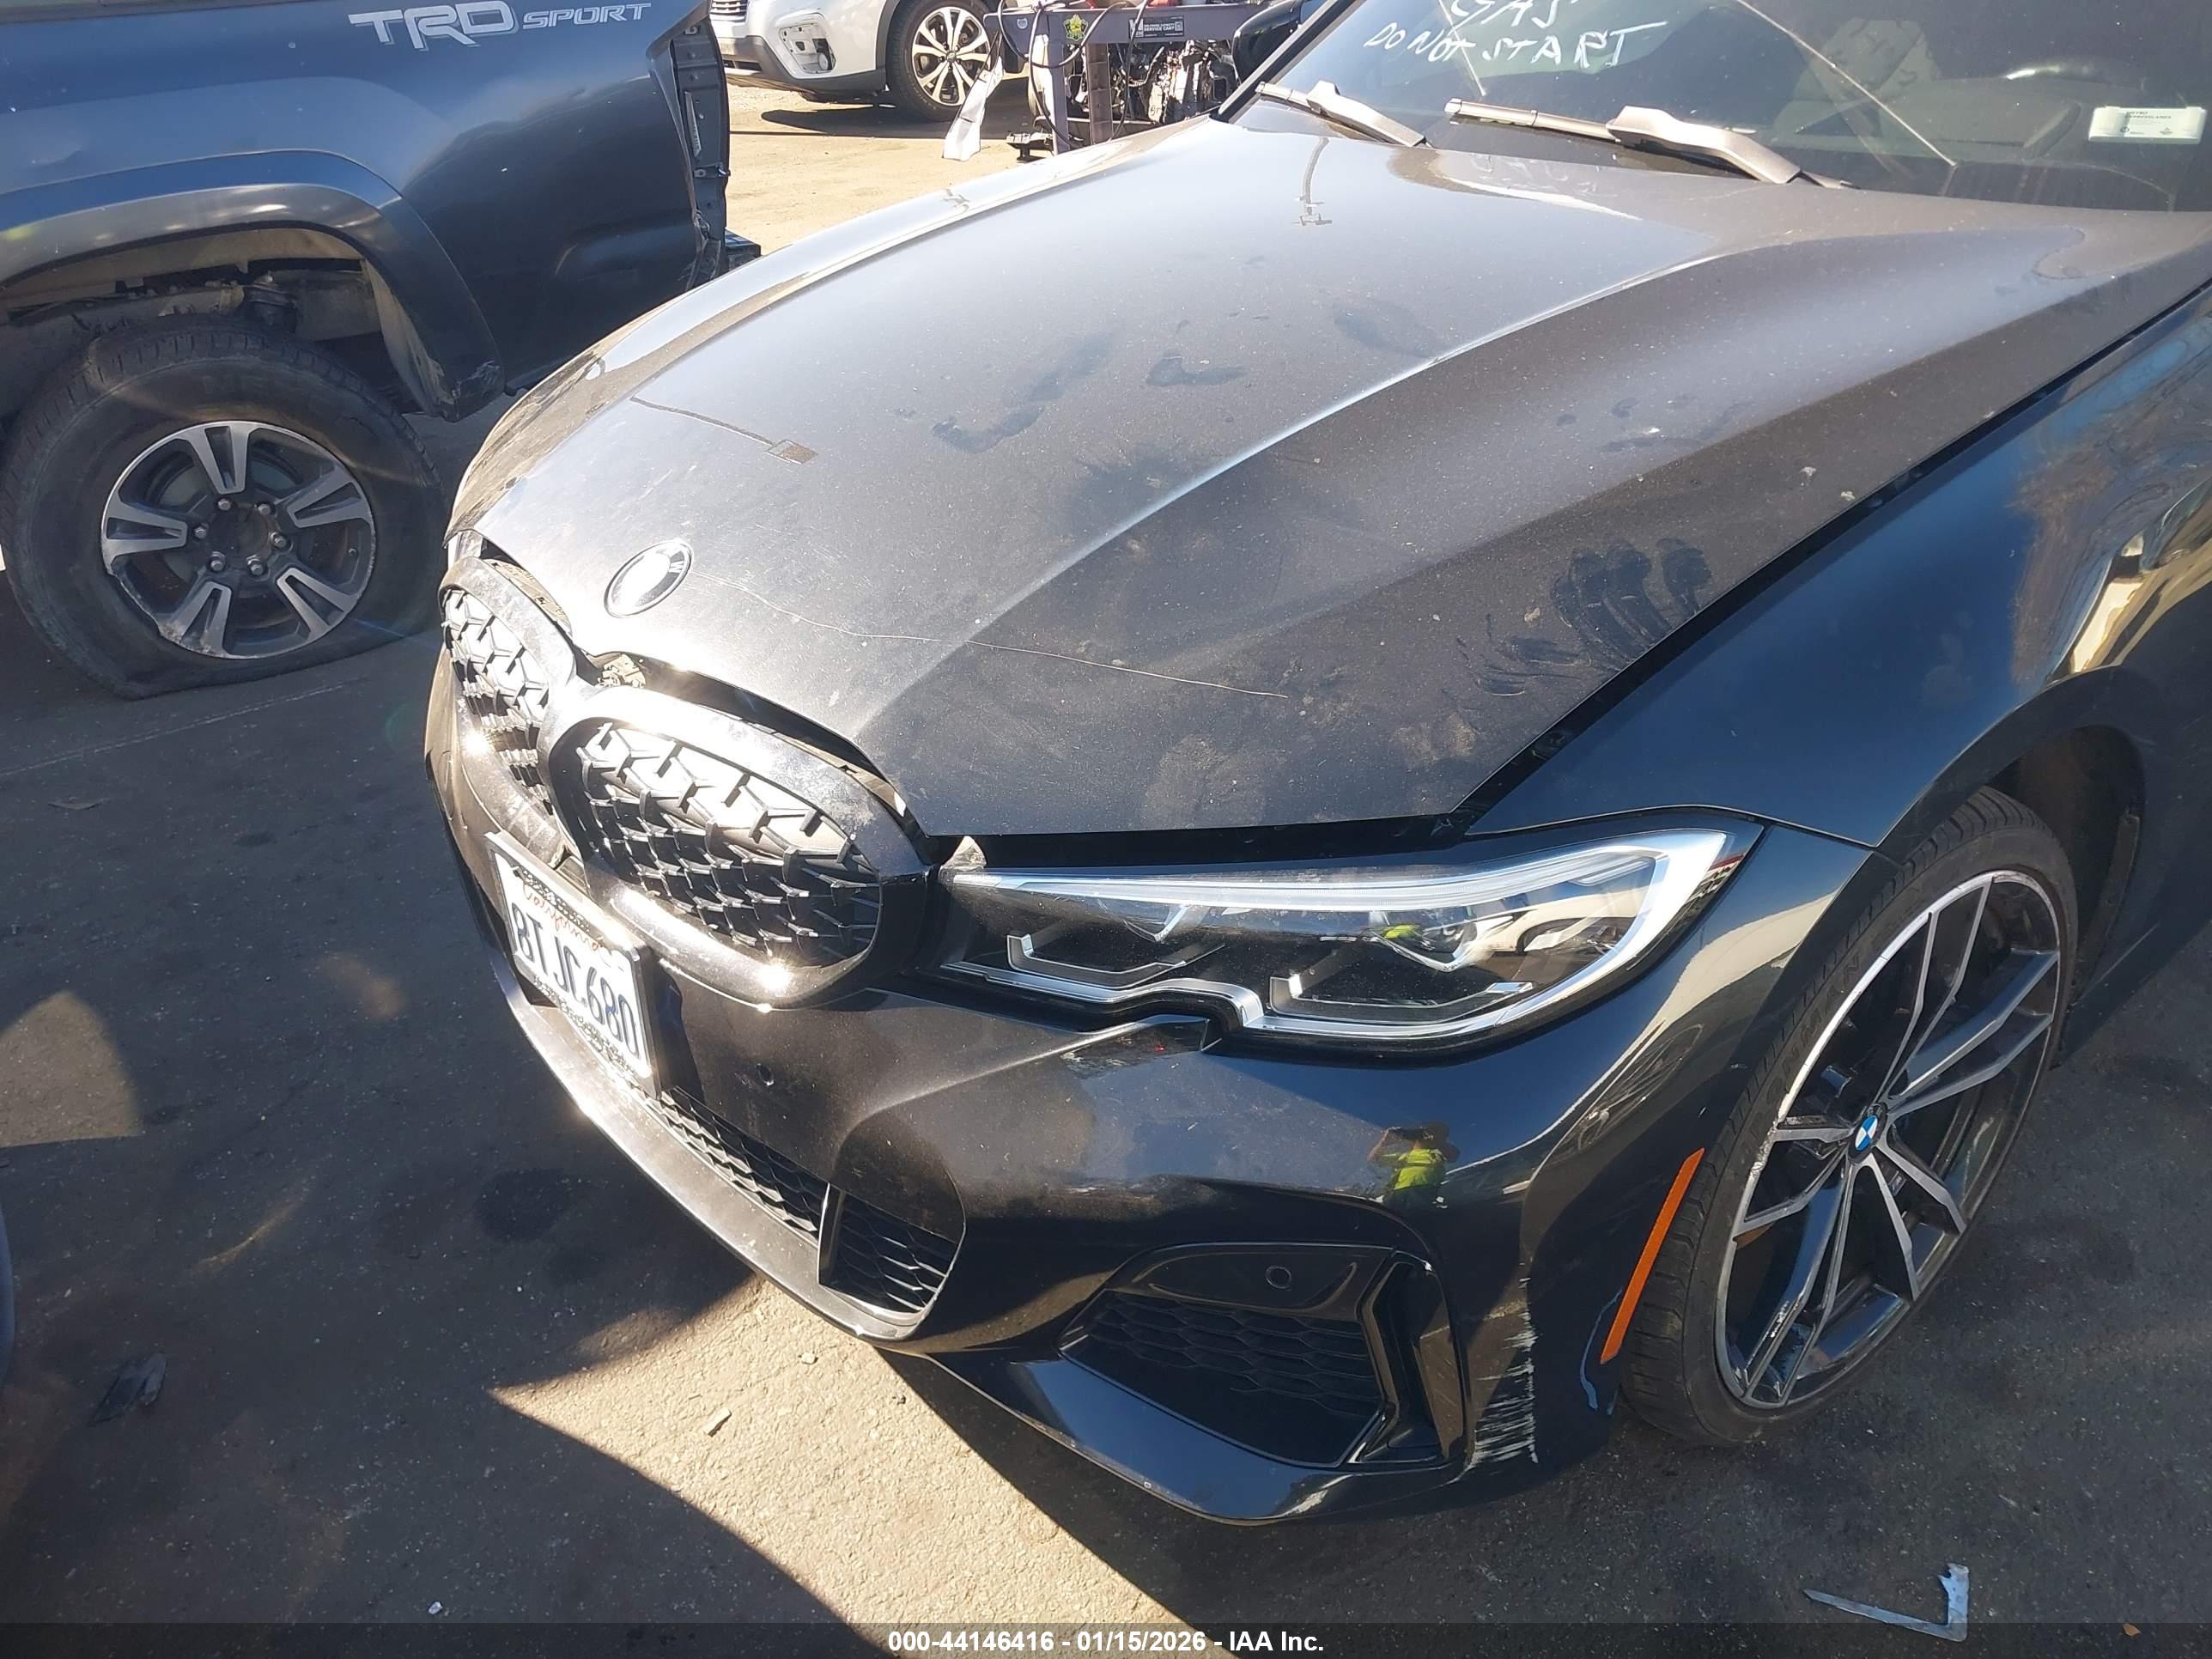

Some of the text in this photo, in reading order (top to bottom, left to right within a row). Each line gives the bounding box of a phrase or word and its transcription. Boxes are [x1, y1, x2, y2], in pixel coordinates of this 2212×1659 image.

[349, 0, 653, 50] TRD SPORT
[1363, 21, 1668, 69] DO NOT START
[511, 902, 642, 1060] 8TJC680
